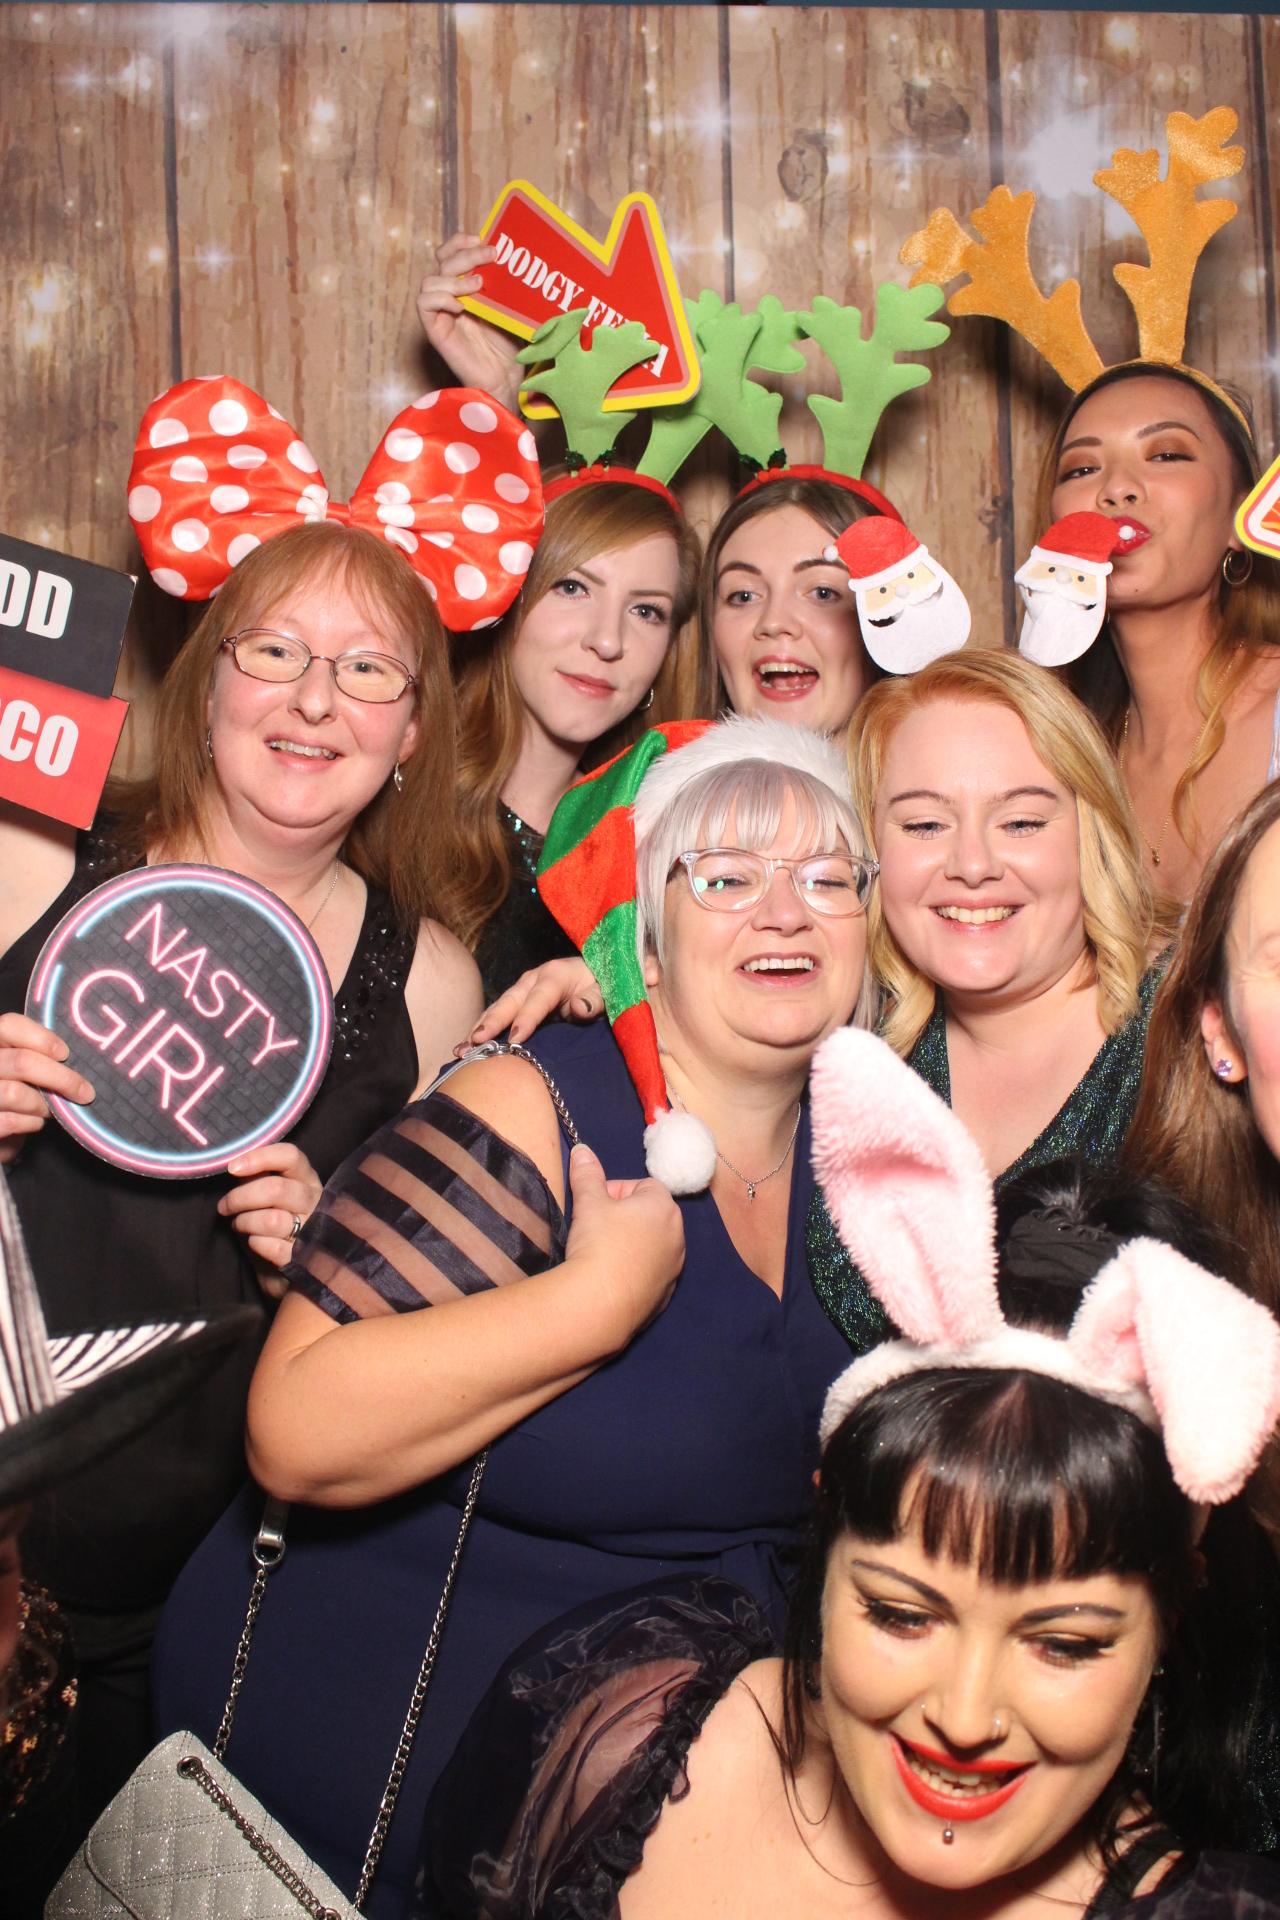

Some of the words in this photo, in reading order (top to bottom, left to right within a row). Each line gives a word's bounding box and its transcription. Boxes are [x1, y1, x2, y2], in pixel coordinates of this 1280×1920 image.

[494, 233, 584, 312] DODGY
[583, 296, 669, 378] FEA
[0, 699, 79, 777] CO
[72, 969, 208, 1145] GIRL
[125, 902, 298, 1066] NASTY
